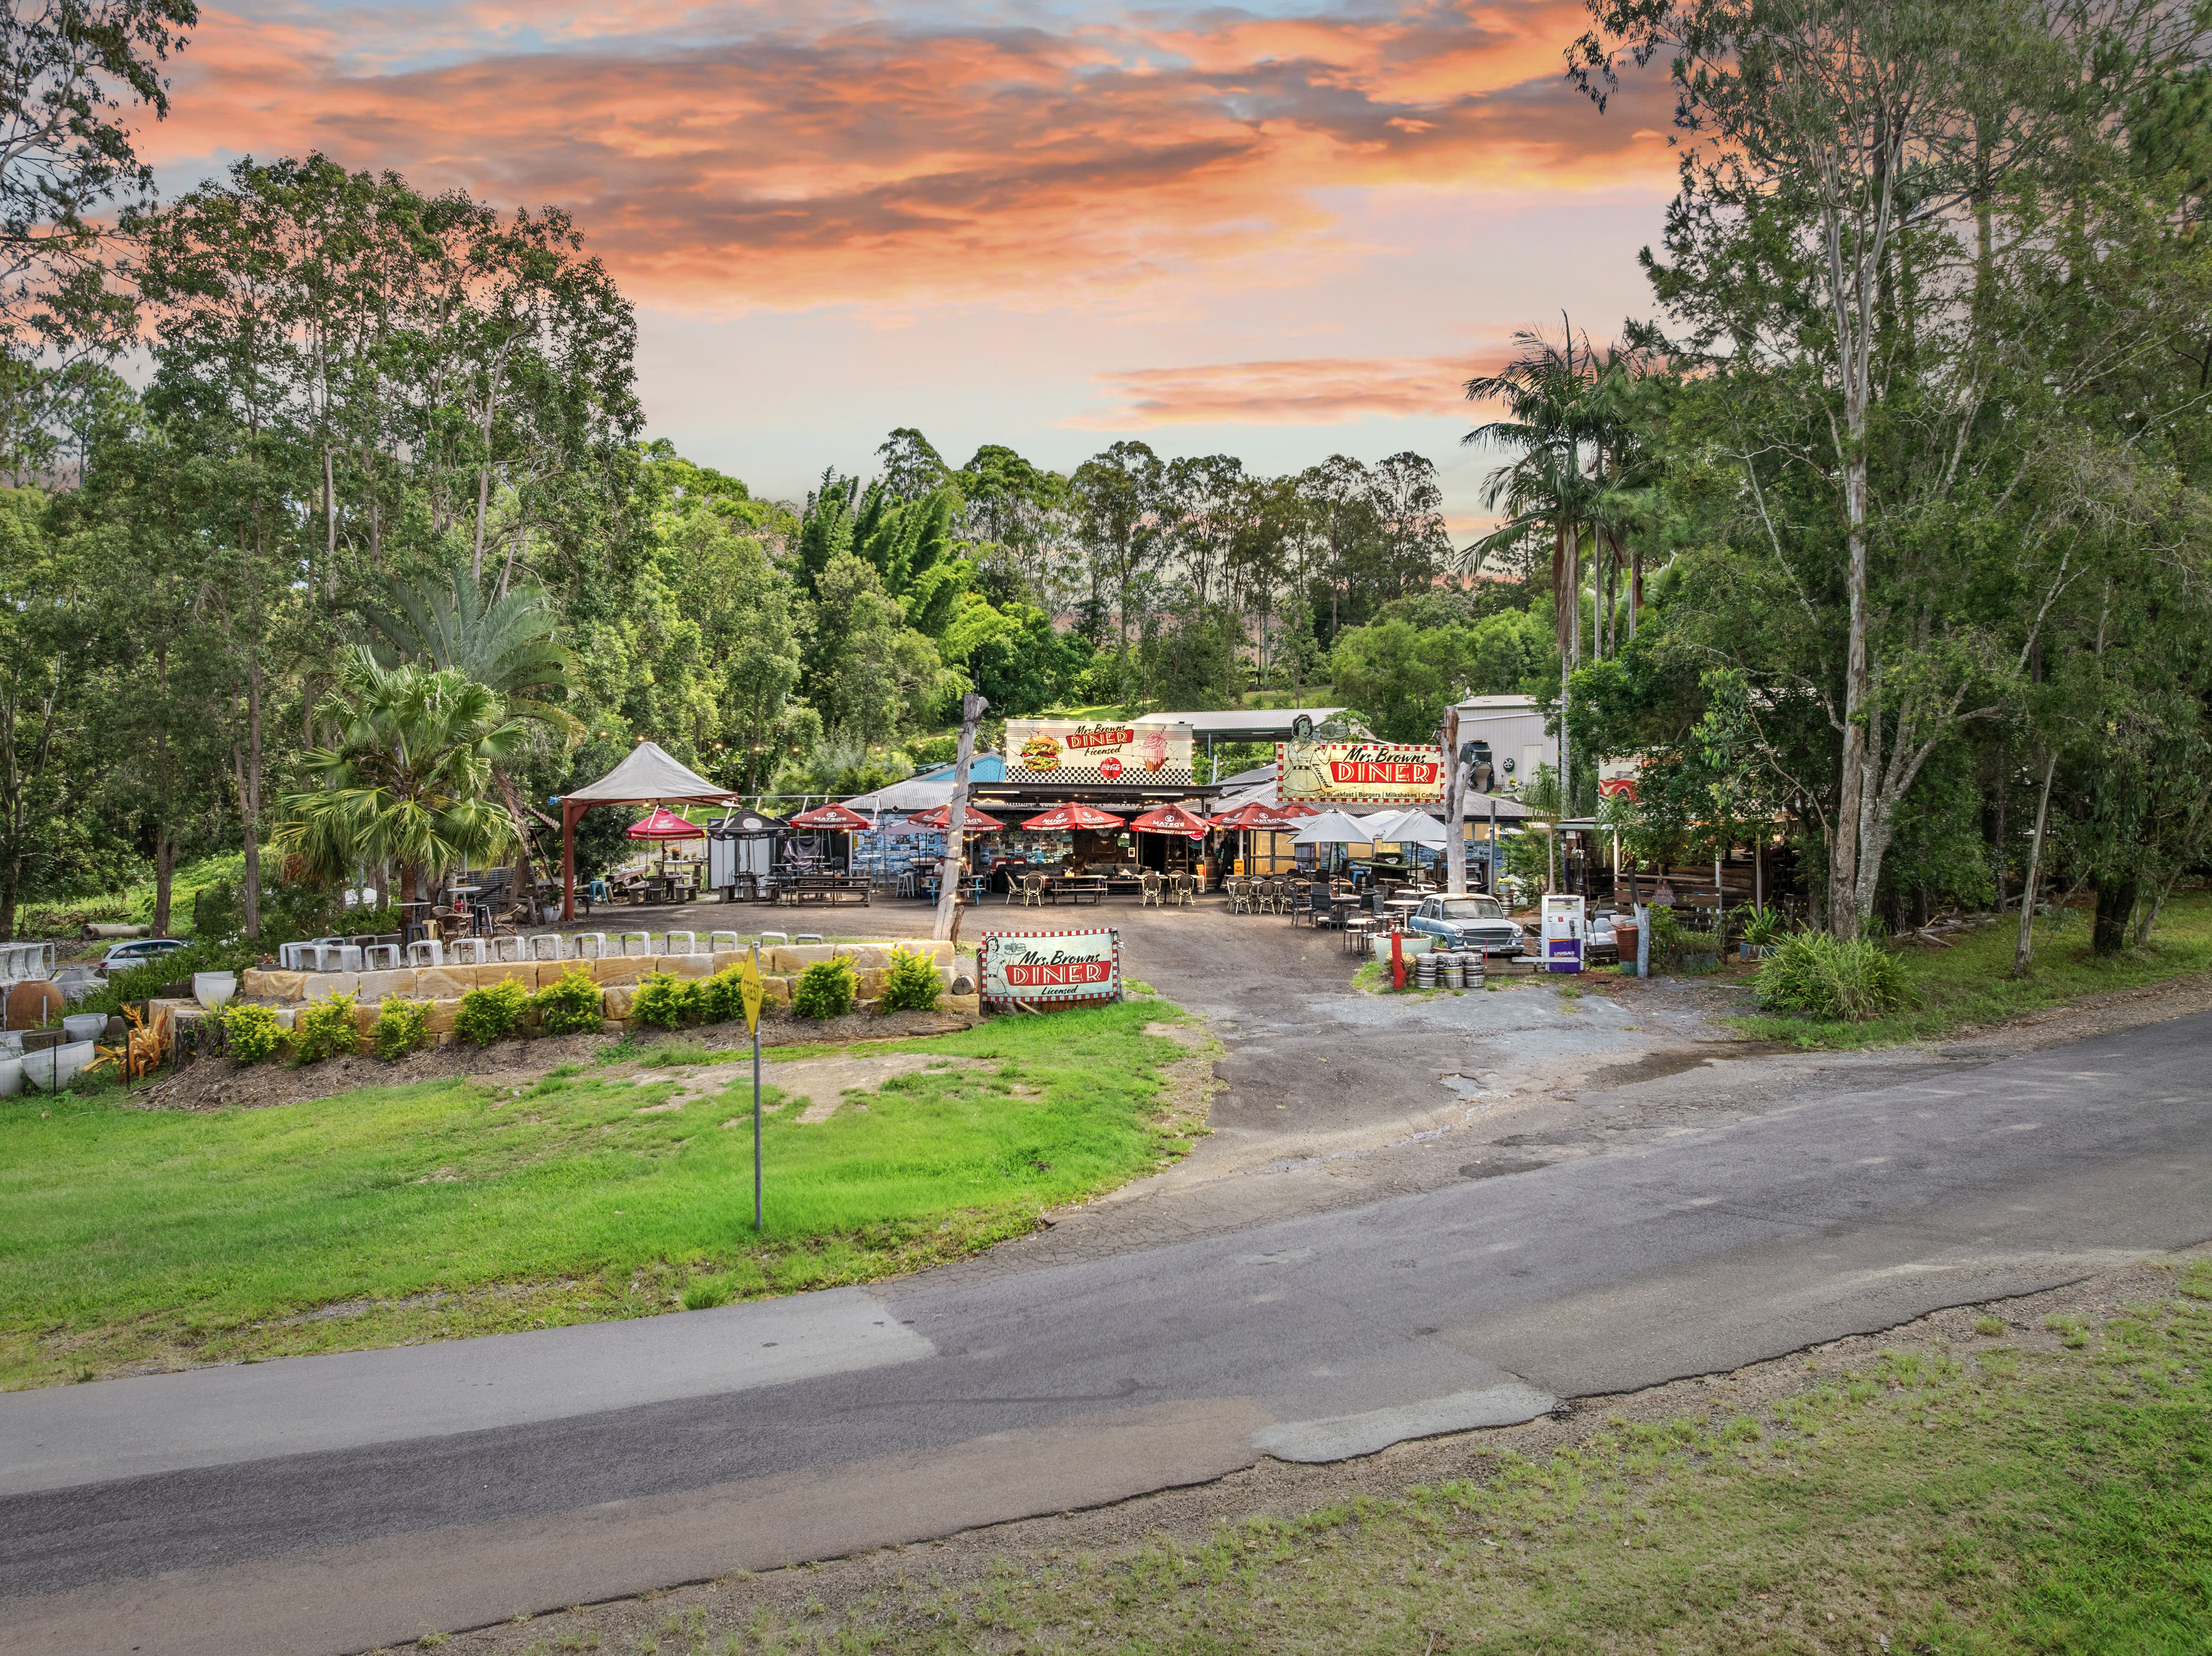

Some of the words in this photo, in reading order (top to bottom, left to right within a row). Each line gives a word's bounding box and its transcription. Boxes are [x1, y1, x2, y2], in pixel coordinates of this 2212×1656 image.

[1071, 732, 1127, 748] DINER
[1084, 744, 1122, 756] Licensed
[1373, 747, 1427, 763] Browns
[1312, 763, 1333, 788] Licensed
[1338, 763, 1430, 783] DINER
[1049, 950, 1100, 966] Browns
[1013, 964, 1102, 984] DINER
[1041, 985, 1079, 995] Licensed
